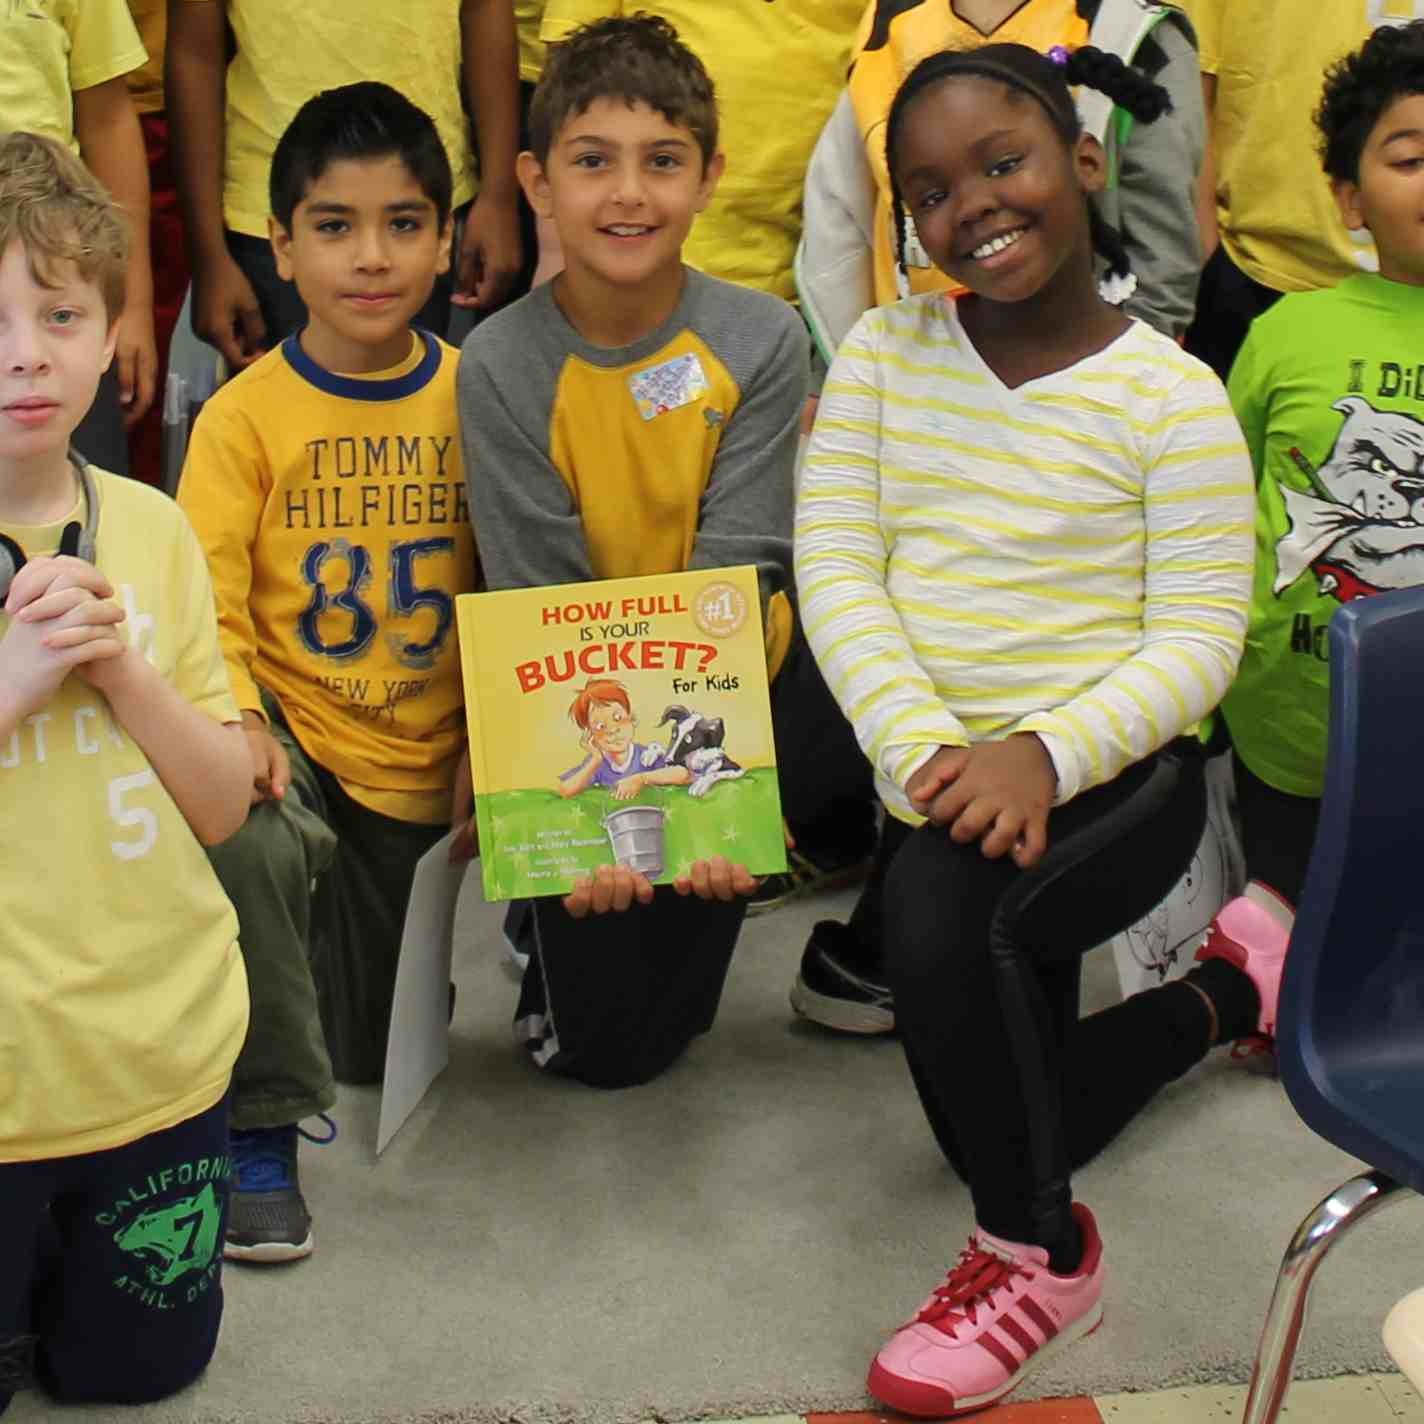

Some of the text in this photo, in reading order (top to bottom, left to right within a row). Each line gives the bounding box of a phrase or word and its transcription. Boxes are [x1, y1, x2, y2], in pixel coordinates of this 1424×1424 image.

[1348, 359, 1367, 394] I
[305, 435, 452, 481] TOMMY
[284, 482, 471, 529] HILFIGER
[297, 536, 457, 664] 85
[541, 594, 689, 626] HOW FULL
[702, 590, 737, 622] #1
[579, 620, 650, 642] IS YOUR
[514, 640, 719, 695] BUCKET?
[672, 672, 740, 695] For Kids
[108, 766, 159, 861] 5
[173, 1207, 205, 1262] 7
